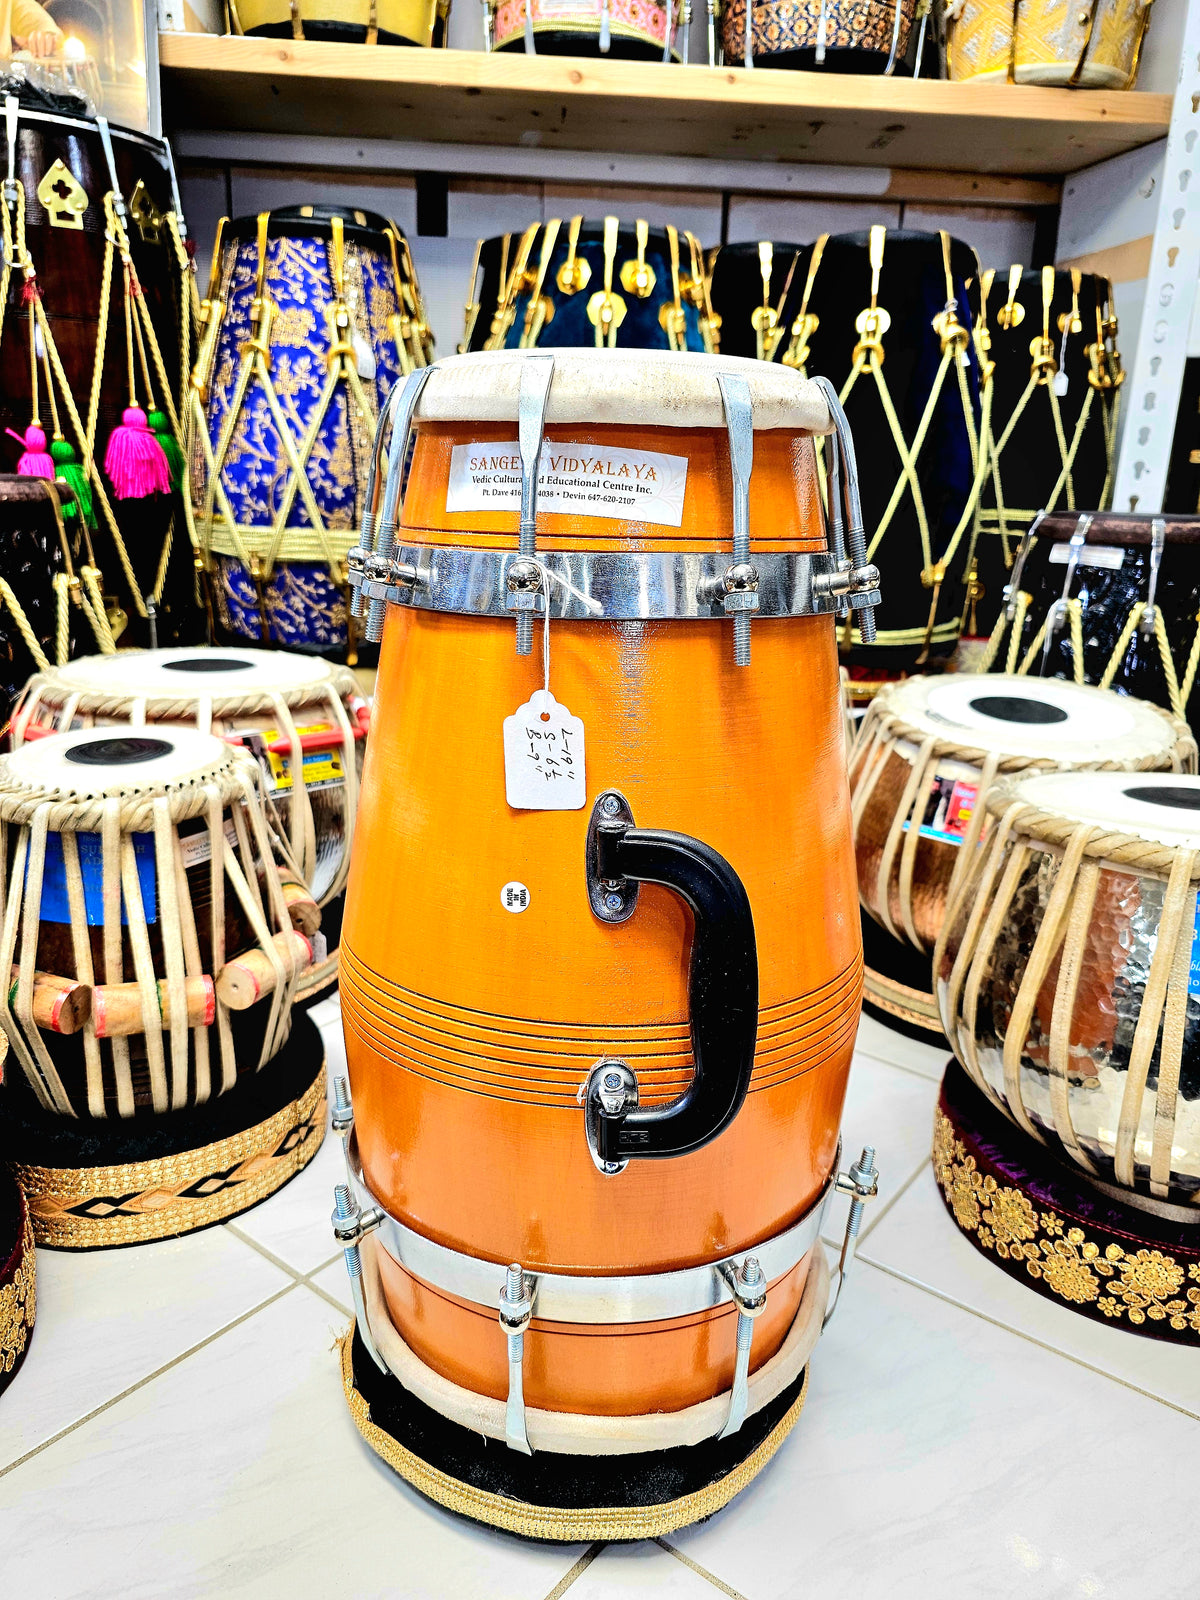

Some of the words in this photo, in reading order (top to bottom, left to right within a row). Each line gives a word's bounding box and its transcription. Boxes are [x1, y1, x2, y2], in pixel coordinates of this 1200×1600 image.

[549, 455, 658, 481] VIDYALAYA
[472, 475, 492, 484] Vedic
[493, 474, 522, 484] Cultura
[547, 476, 600, 488] Educational
[602, 480, 634, 492] Centre
[635, 484, 653, 494] Inc.
[562, 491, 586, 500] Devin
[587, 493, 636, 505] 647-620-2107
[506, 887, 514, 907] MADE
[513, 893, 520, 902] IN
[519, 888, 527, 907] INDIA
